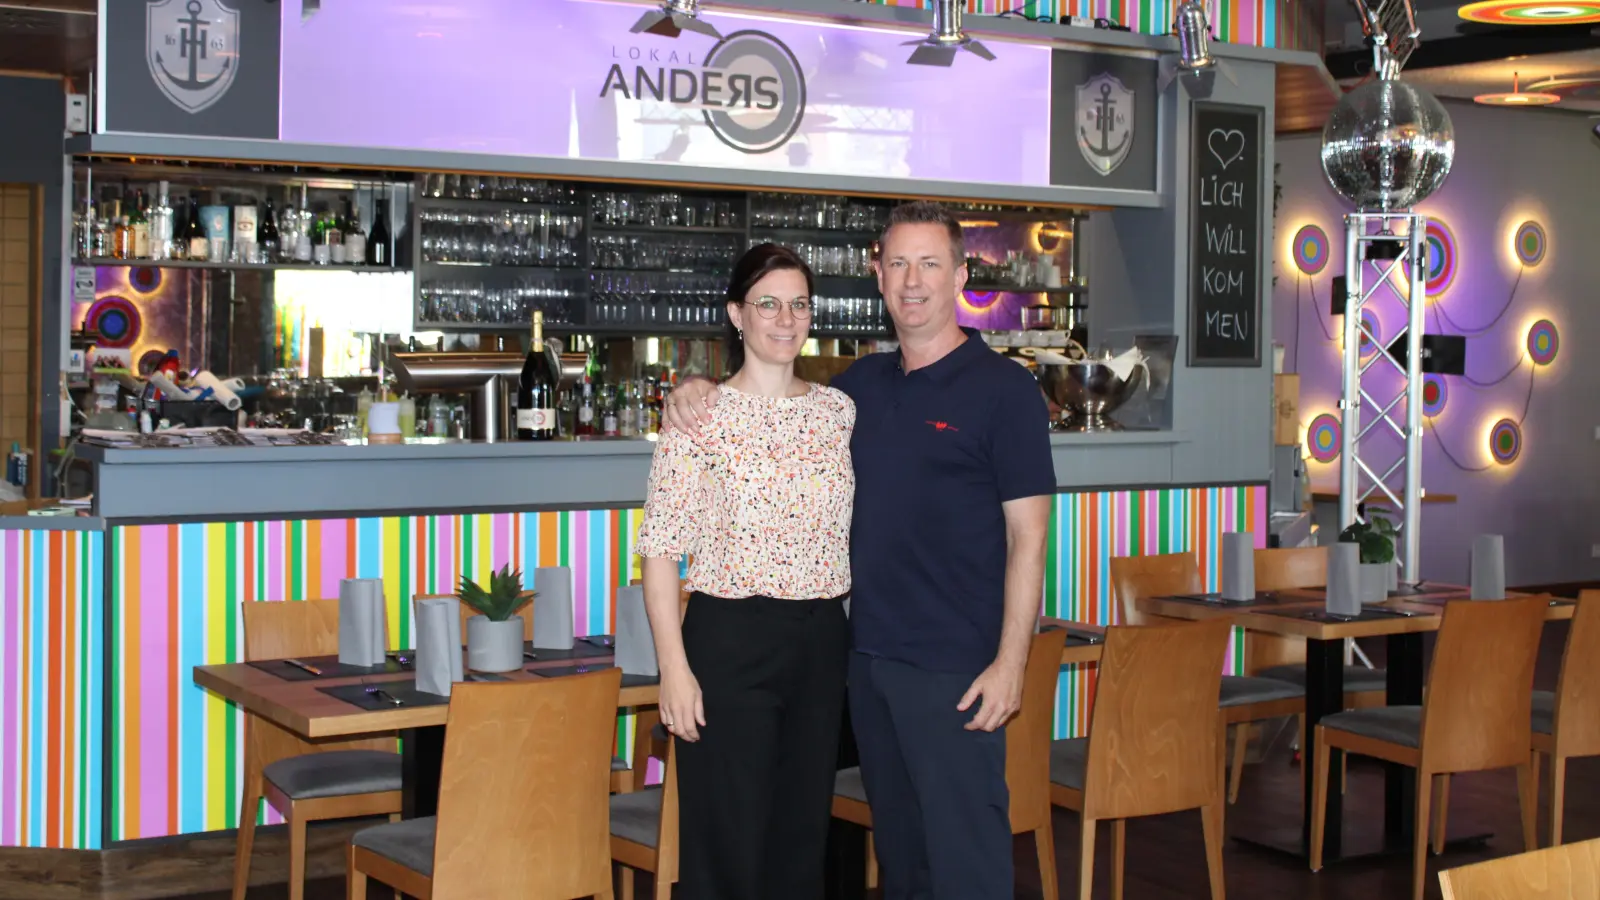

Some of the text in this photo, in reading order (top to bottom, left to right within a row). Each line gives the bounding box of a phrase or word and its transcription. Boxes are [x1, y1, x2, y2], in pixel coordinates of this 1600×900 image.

[612, 45, 696, 65] LOKAL
[1203, 265, 1244, 296] KOM
[1206, 310, 1248, 341] MEN
